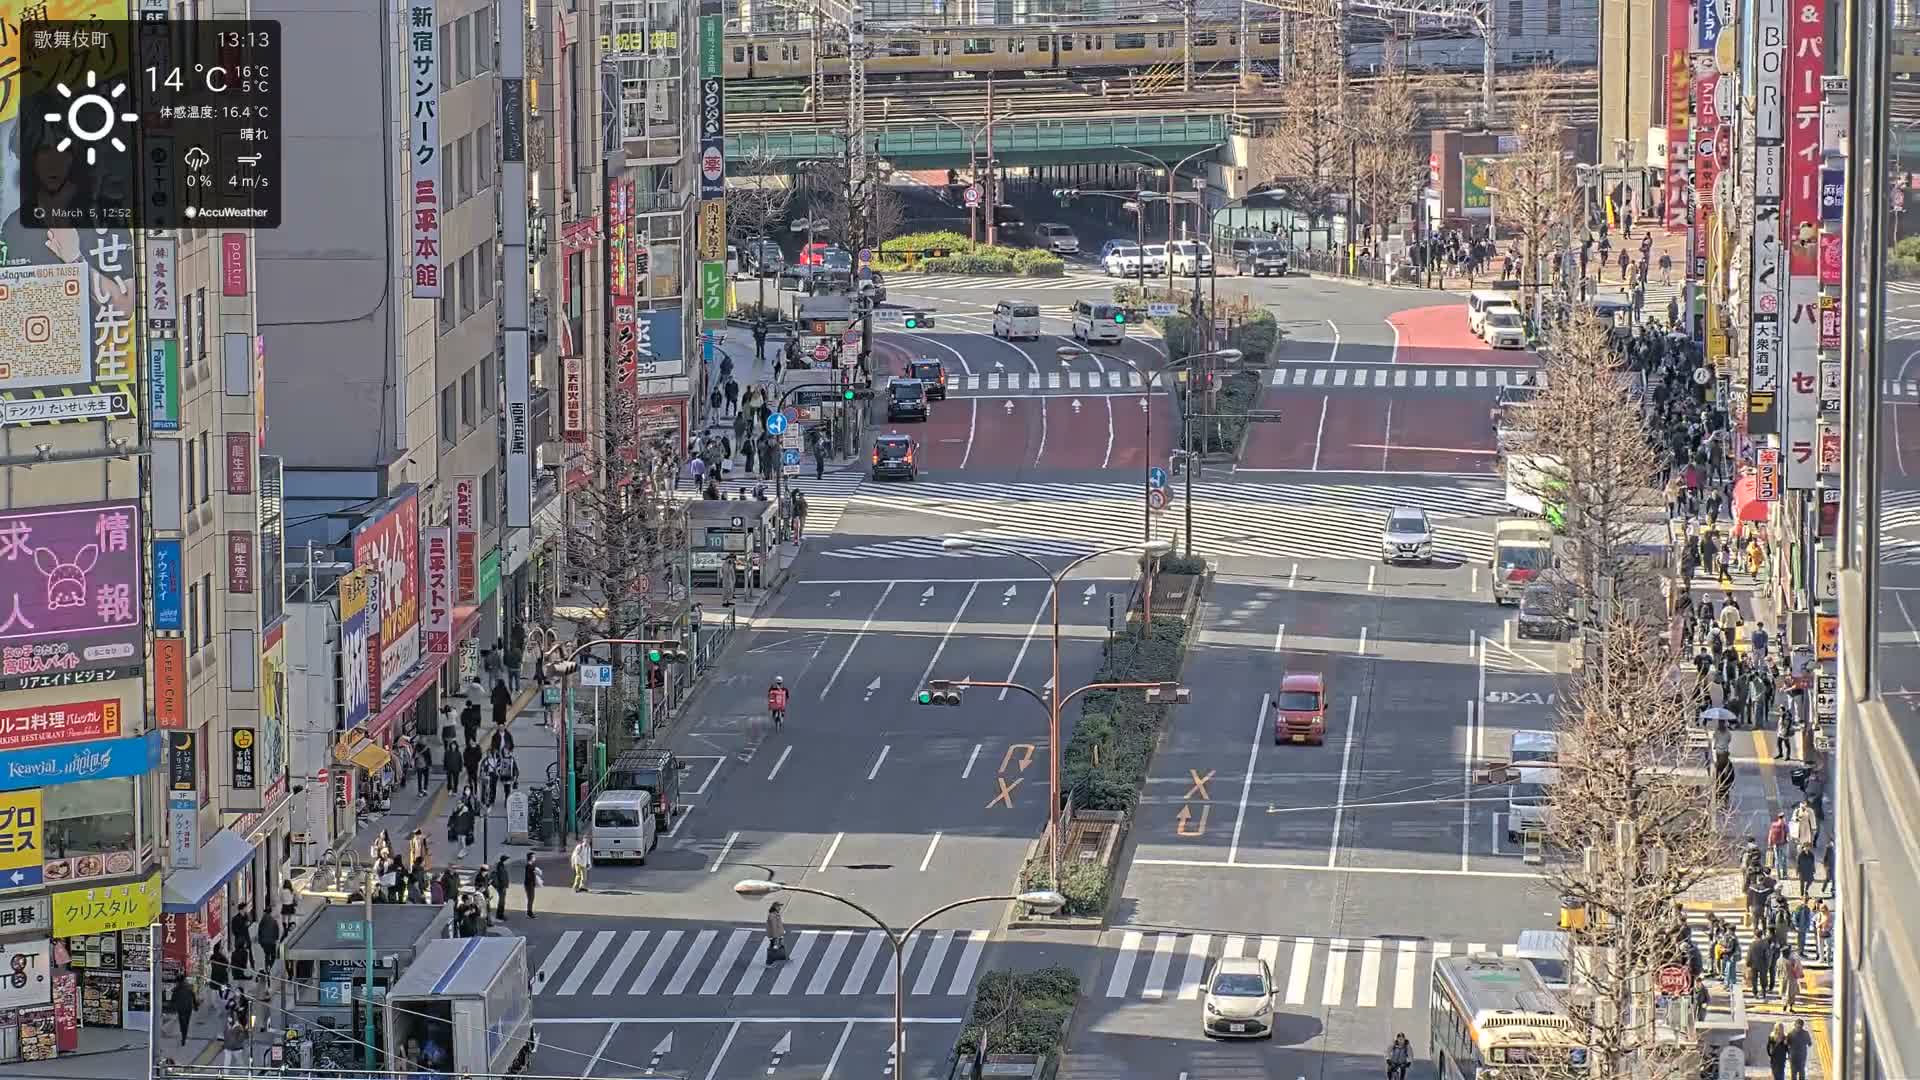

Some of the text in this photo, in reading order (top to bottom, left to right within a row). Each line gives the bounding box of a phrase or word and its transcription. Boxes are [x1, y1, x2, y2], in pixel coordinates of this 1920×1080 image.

[412, 6, 438, 286] 新宿サンパーク 三平本館
[707, 202, 719, 258] 肉汁水餃子
[706, 271, 719, 308] レイク
[1756, 325, 1770, 377] 大衆酒場
[153, 348, 165, 409] FamilyMart
[1791, 304, 1817, 464] パセラ
[9, 400, 108, 416] テンクリ たいせい先生
[710, 537, 721, 546] 10
[234, 543, 247, 578] 龍生堂
[430, 537, 445, 624] 三平ストア
[3, 643, 69, 658] 女の子のための
[3, 653, 80, 675] 高収入バイト
[20, 669, 116, 689] リアエイド ビジョン
[106, 707, 116, 731] 5F
[22, 730, 65, 743] RESTAURANT
[0, 808, 36, 828] プロ
[0, 906, 35, 927] 囲碁
[66, 898, 137, 922] クリスタル
[323, 987, 339, 1000] 12
